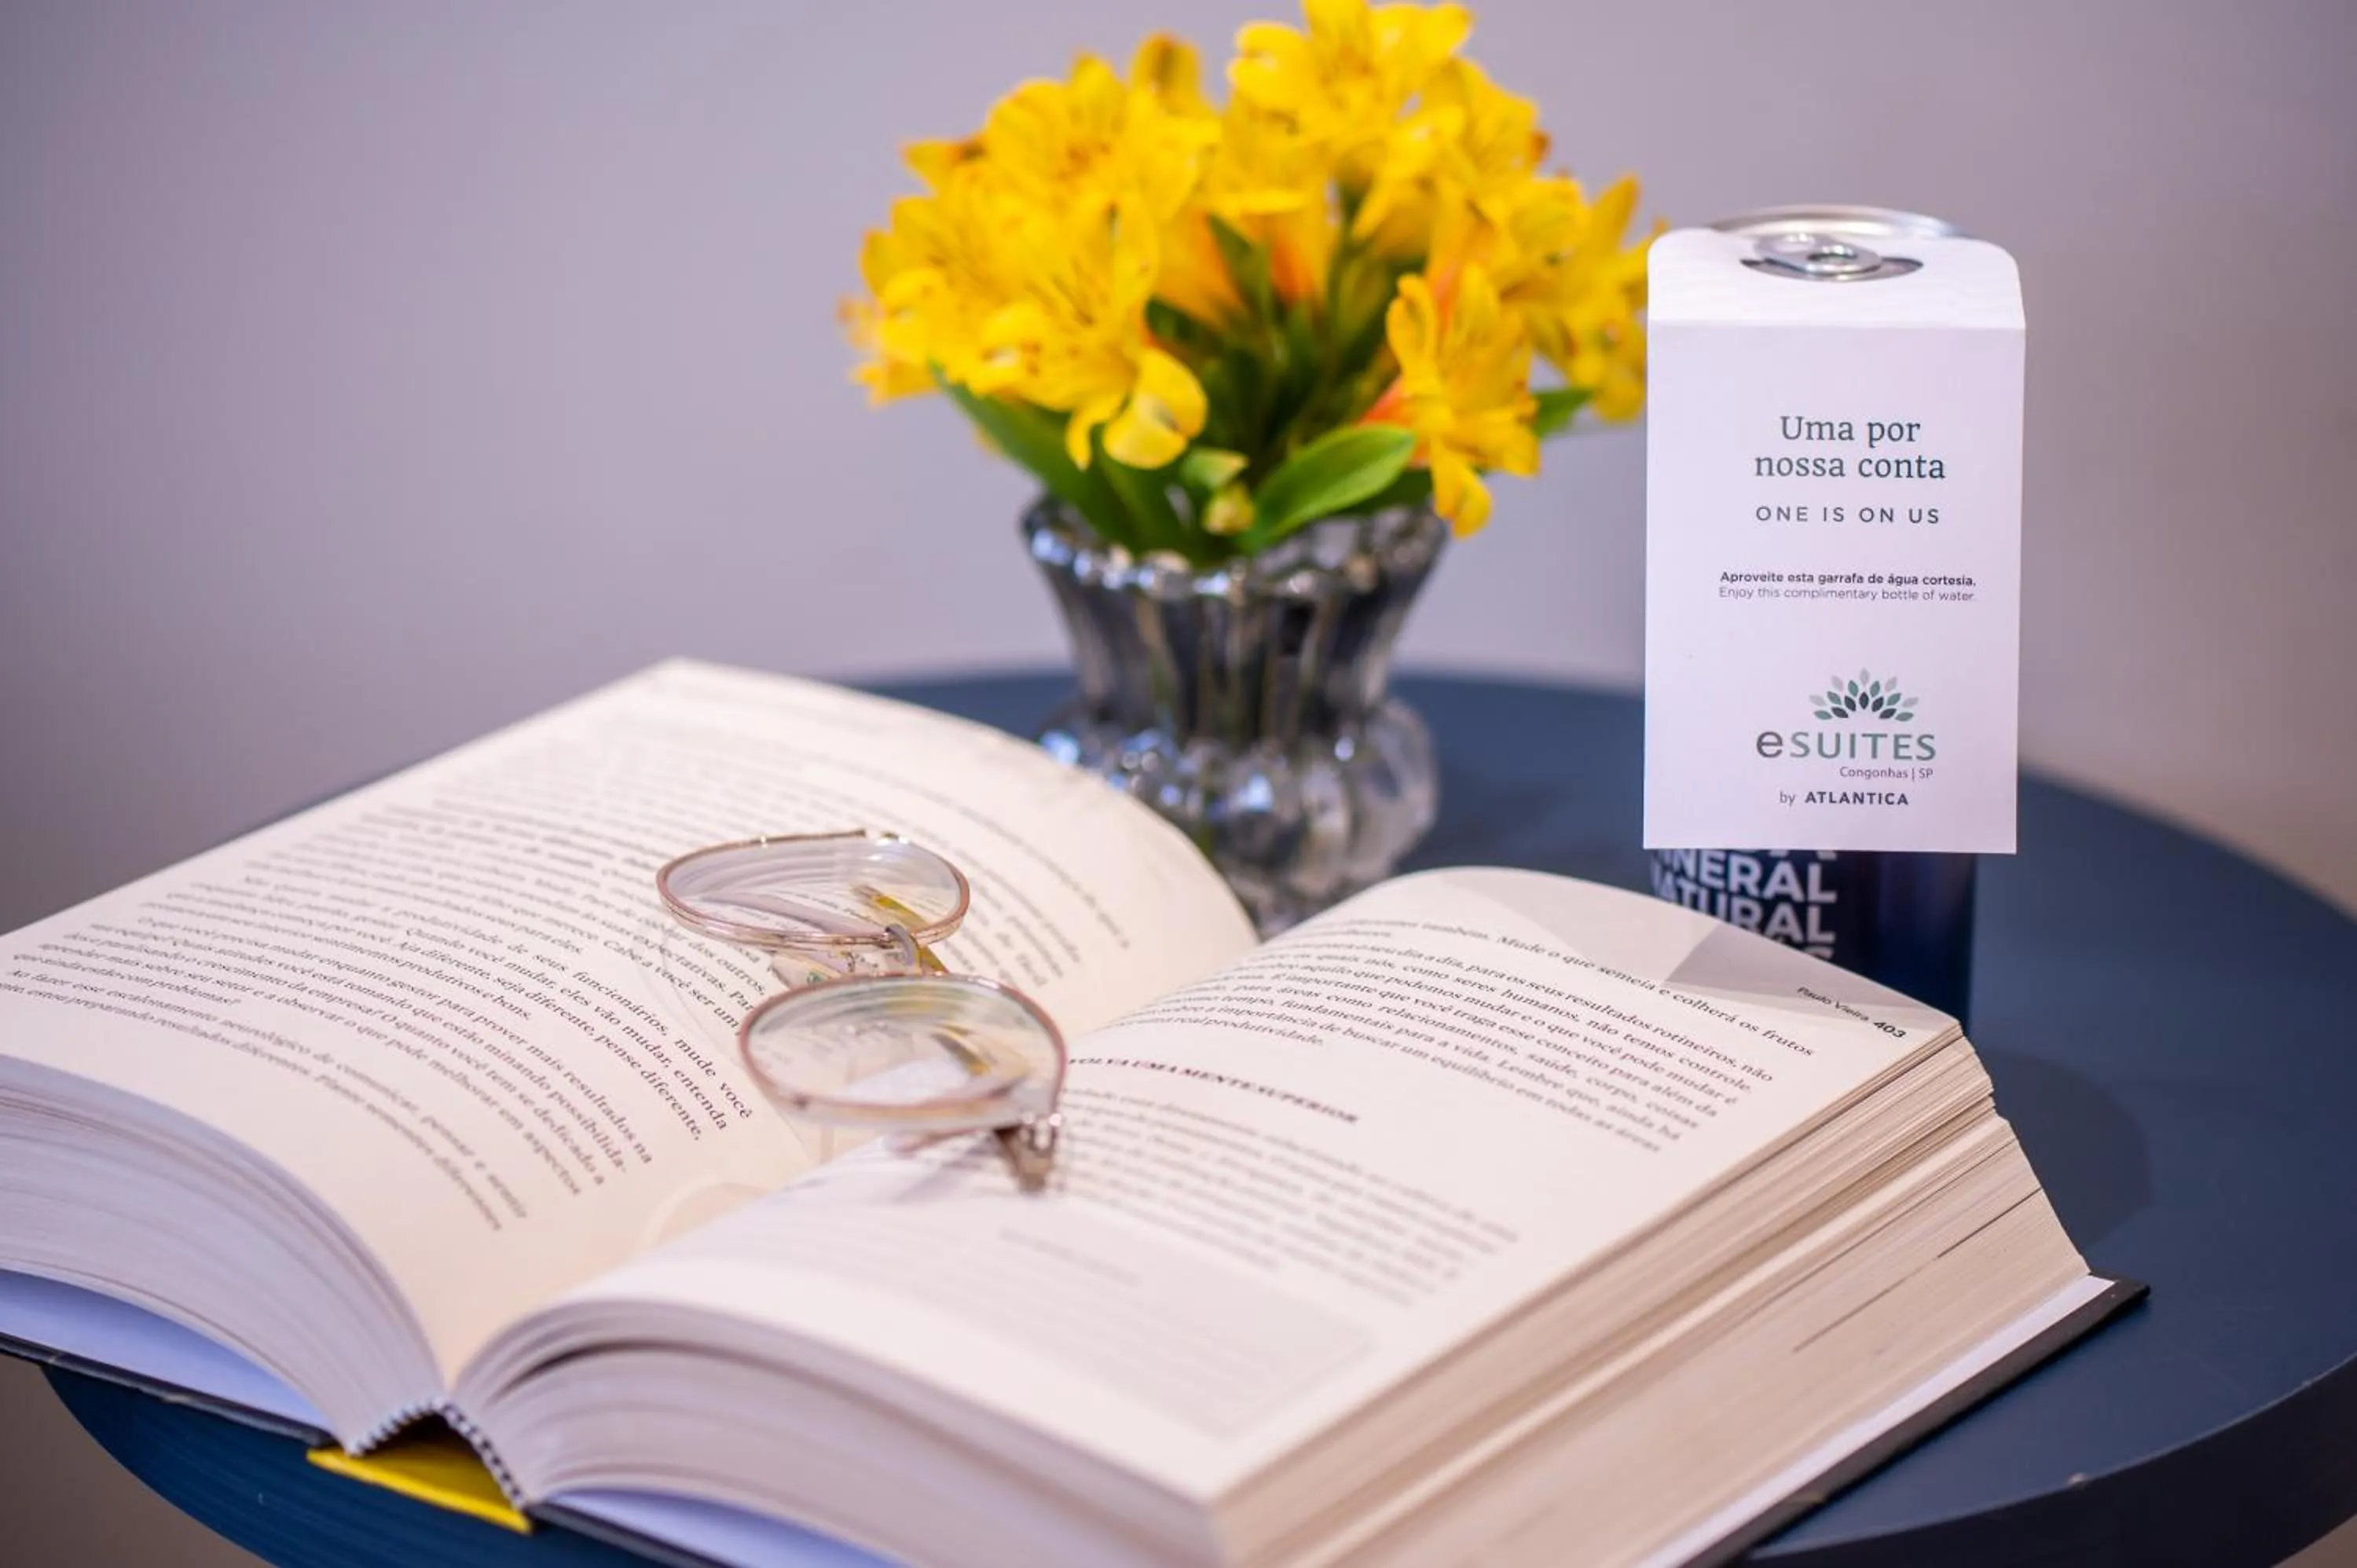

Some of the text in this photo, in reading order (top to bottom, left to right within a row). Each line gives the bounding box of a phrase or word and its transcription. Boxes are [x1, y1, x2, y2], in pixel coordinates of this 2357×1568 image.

[1754, 455, 1946, 479] nossa conta
[1780, 416, 1921, 449] Uma por
[1756, 506, 1940, 524] ONE IS ON US
[1719, 587, 1976, 602] Enjoy this complimentary bottle of water.
[1720, 571, 1783, 584] Aproveite
[1787, 573, 1814, 584] esta
[1818, 573, 1864, 587] garrafa
[1868, 573, 1883, 584] de
[1887, 573, 1919, 588] água
[1780, 790, 1909, 807] by ATLANTICA
[1839, 766, 1934, 780] Congonhas SP
[654, 965, 693, 989] você
[689, 987, 717, 1007] ser
[716, 958, 764, 996] outros,
[1402, 965, 1450, 979] como
[1452, 976, 1496, 993] seres
[1500, 988, 1581, 1023] humanos,
[1587, 1019, 1620, 1036] não
[1623, 1033, 1676, 1058] temos
[1496, 936, 1545, 954] Mude
[1547, 950, 1560, 959] o
[1561, 954, 1596, 969] que
[1596, 965, 1655, 991] semeia
[1672, 992, 1738, 1023] colherá
[1738, 1020, 1760, 1032] os
[1761, 1029, 1816, 1057] frutos
[1796, 987, 1907, 1039] Paulo Vieira 403
[420, 947, 703, 1141] diferente, seja diferente, pense diferente,
[467, 945, 506, 963] você
[504, 959, 557, 989] mudar,
[559, 986, 592, 1007] eles
[594, 1005, 621, 1026] vão
[621, 1024, 673, 1069] mudar,
[673, 1068, 728, 1131] entenda
[507, 943, 753, 1120] de seus funcionários, mude você
[1281, 998, 1395, 1031] fundamentais
[1395, 1027, 1436, 1044] para
[1496, 1058, 1565, 1090] Lembre
[1605, 1104, 1655, 1130] ainda
[1286, 975, 1718, 1119] importante que você traga esse conceito para além da
[1319, 1022, 1342, 1032] de
[1341, 1027, 1401, 1050] buscar
[1398, 1044, 1431, 1060] um
[1431, 1055, 1515, 1090] equilíbrio
[1516, 1086, 1544, 1101] em
[1325, 995, 1373, 1009] como
[1377, 1005, 1519, 1056] relacionamentos,
[1526, 1052, 1579, 1079] saúde,
[1384, 976, 1463, 999] podemos
[1463, 995, 1521, 1017] mudar
[1533, 1018, 1546, 1027] o
[1547, 1024, 1580, 1039] que
[1582, 1036, 1622, 1054] você
[1619, 1052, 1666, 1074] pode
[1666, 1071, 1725, 1098] mudar
[1465, 963, 1506, 980] para
[1506, 975, 1527, 985] os
[1527, 982, 1565, 998] seus
[1565, 993, 1652, 1031] resultados
[1652, 1026, 1737, 1068] rotineiros,
[1741, 1064, 1774, 1083] não
[310, 972, 346, 986] está
[343, 981, 412, 1009] tomando
[412, 1006, 442, 1024] que
[442, 1020, 485, 1046] estão
[484, 1042, 552, 1091] minando
[547, 1090, 627, 1174] possibilida-
[356, 1025, 388, 1042] que
[384, 1038, 427, 1059] pode
[427, 1058, 500, 1108] melhorar
[498, 1108, 525, 1131] em
[387, 980, 442, 1000] gestor
[436, 998, 476, 1019] para
[472, 1014, 529, 1046] prover
[527, 1044, 564, 1072] mais
[563, 1071, 637, 1141] resultados
[633, 1142, 653, 1163] na
[394, 1021, 450, 1049] quanto
[450, 1046, 489, 1070] você
[486, 1069, 518, 1094] tem
[517, 1093, 536, 1107] se
[533, 1106, 596, 1174] dedicado
[1178, 1067, 1360, 1124] MENTE SUPERIOR
